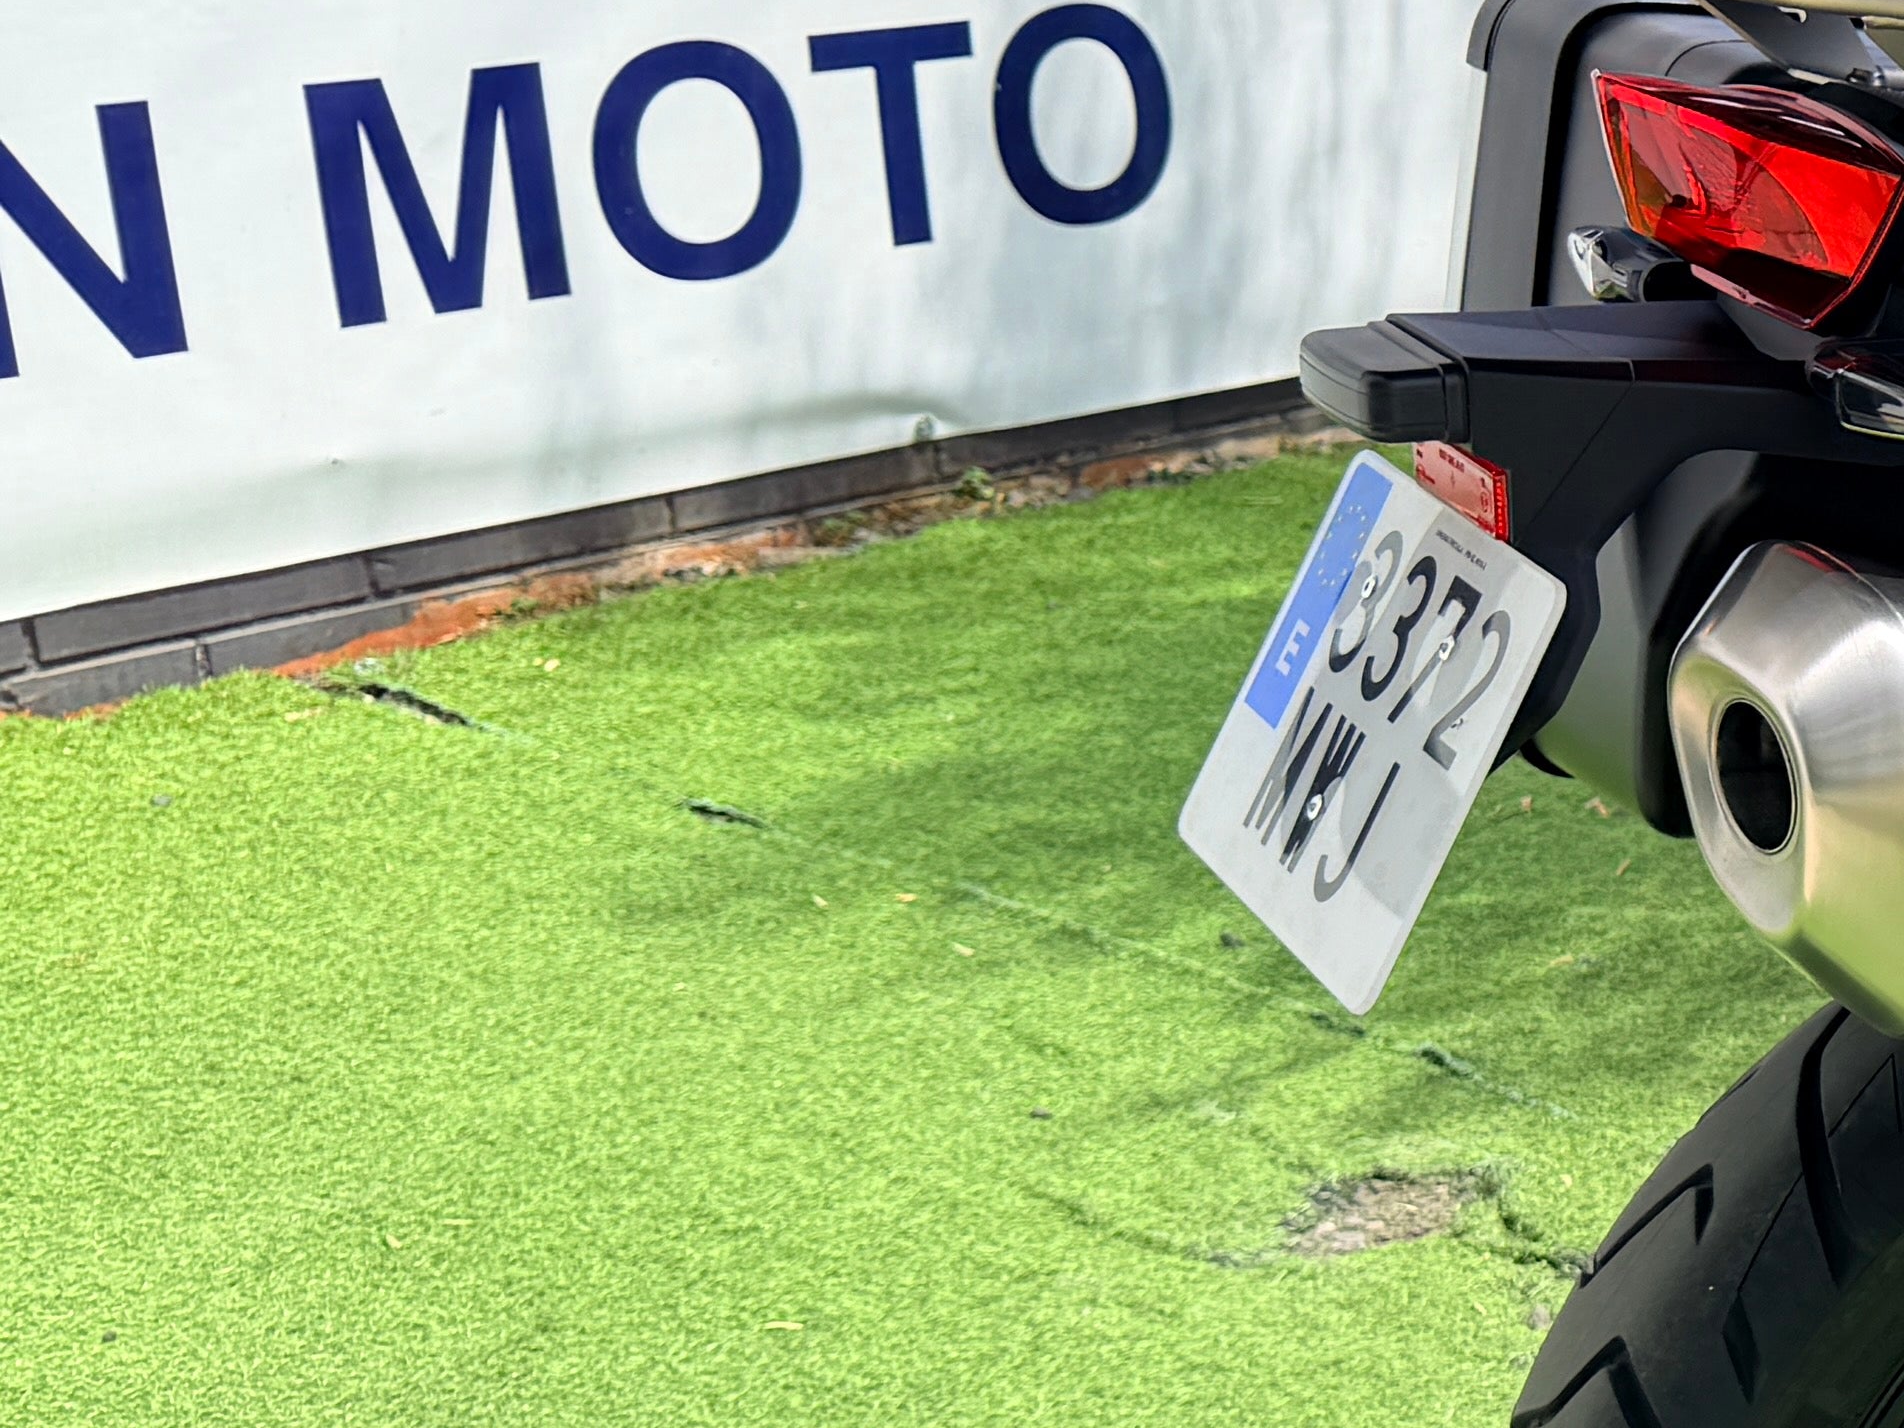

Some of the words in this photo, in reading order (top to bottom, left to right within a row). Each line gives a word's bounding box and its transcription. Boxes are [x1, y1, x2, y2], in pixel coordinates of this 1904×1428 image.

[303, 2, 1172, 328] MOTO
[1275, 619, 1309, 677] E
[1328, 531, 1510, 770] 3372
[1243, 686, 1400, 902] MWJ
